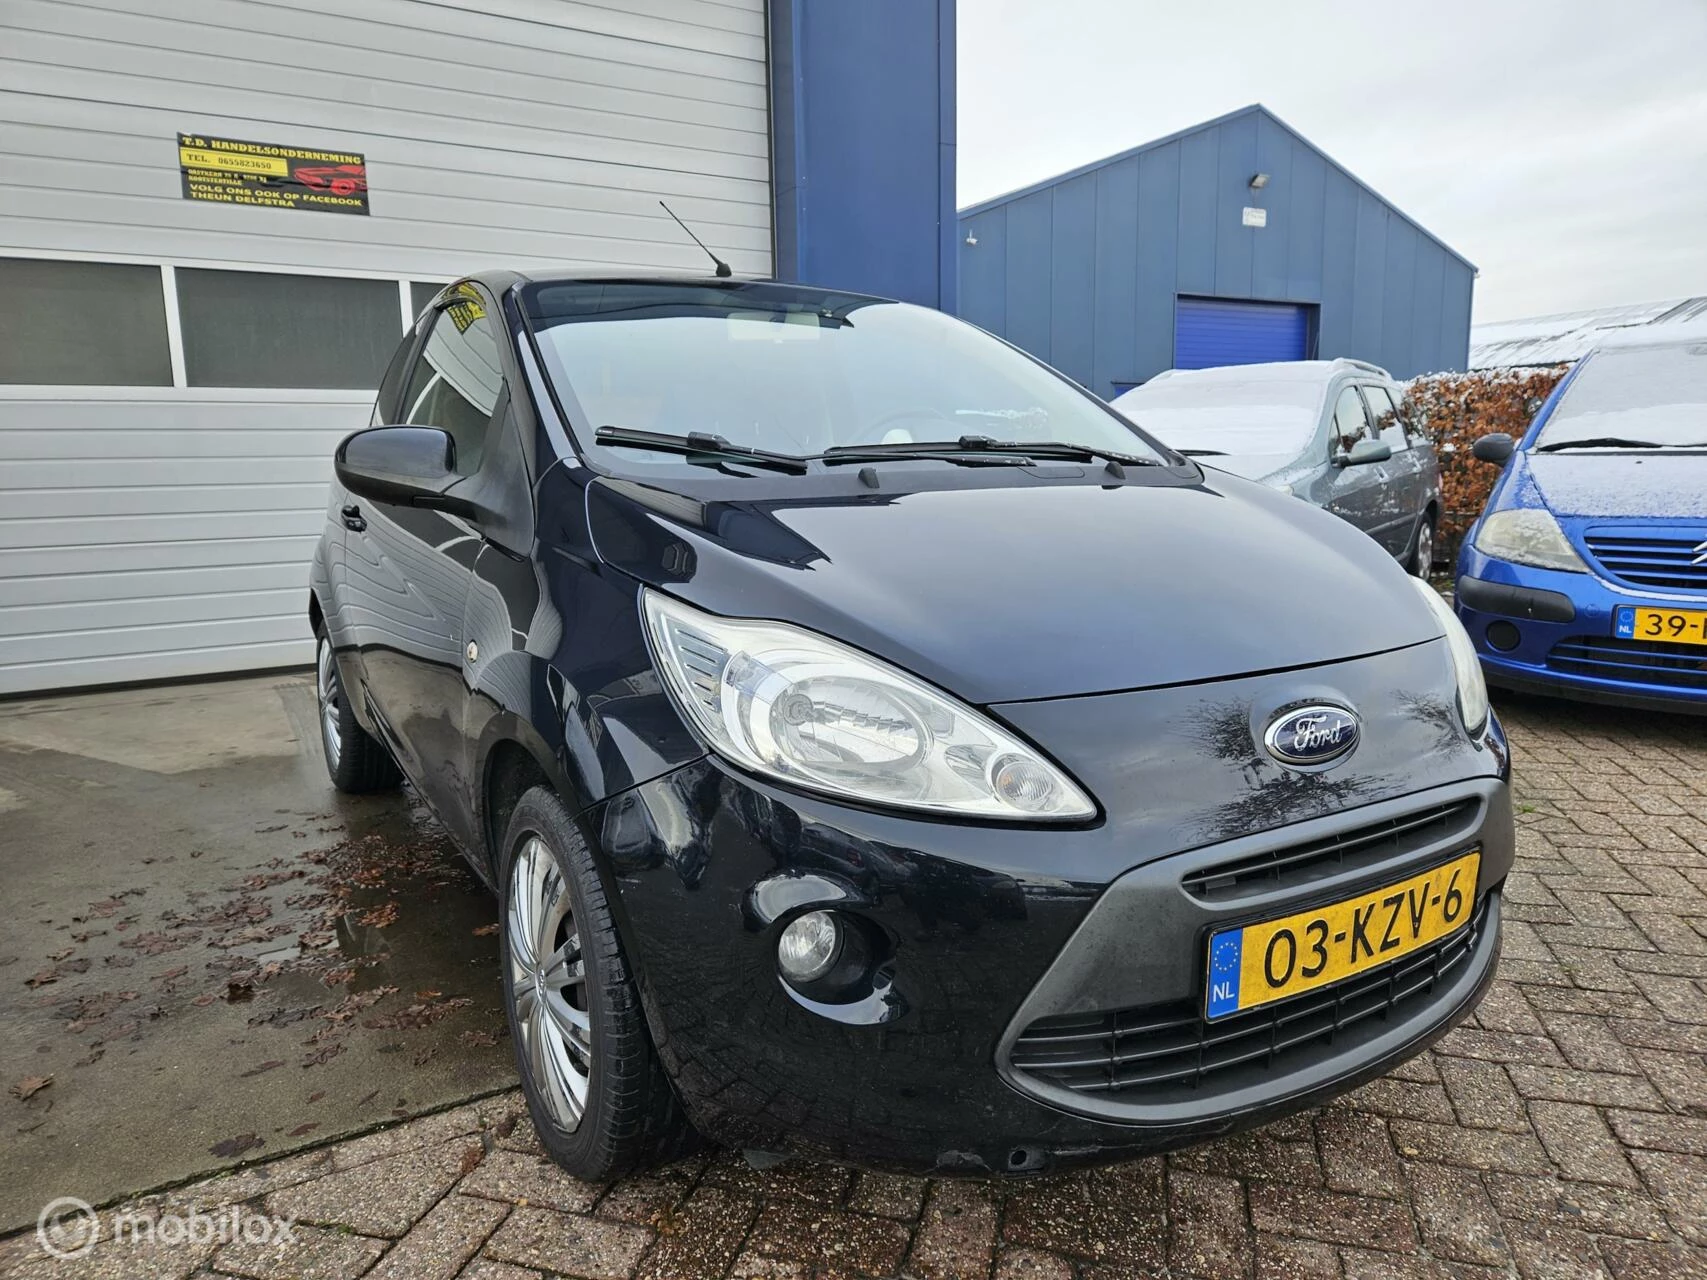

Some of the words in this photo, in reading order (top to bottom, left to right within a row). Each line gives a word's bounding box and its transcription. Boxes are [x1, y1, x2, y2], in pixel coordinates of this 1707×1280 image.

[183, 137, 207, 147] T.D.
[211, 140, 361, 164] HANDELSONDERNEMING
[187, 153, 211, 163] TEL.
[190, 183, 223, 193] VOLG
[226, 187, 251, 196] ONS
[255, 190, 280, 198] OOK
[303, 194, 362, 206] FACEBOOK
[190, 192, 232, 201] THEUN
[235, 195, 295, 207] DELFSTRA
[1619, 625, 1632, 633] NL
[1294, 715, 1342, 751] Ford
[1264, 869, 1462, 988] 03-KZV-6
[1213, 981, 1235, 1002] NL
